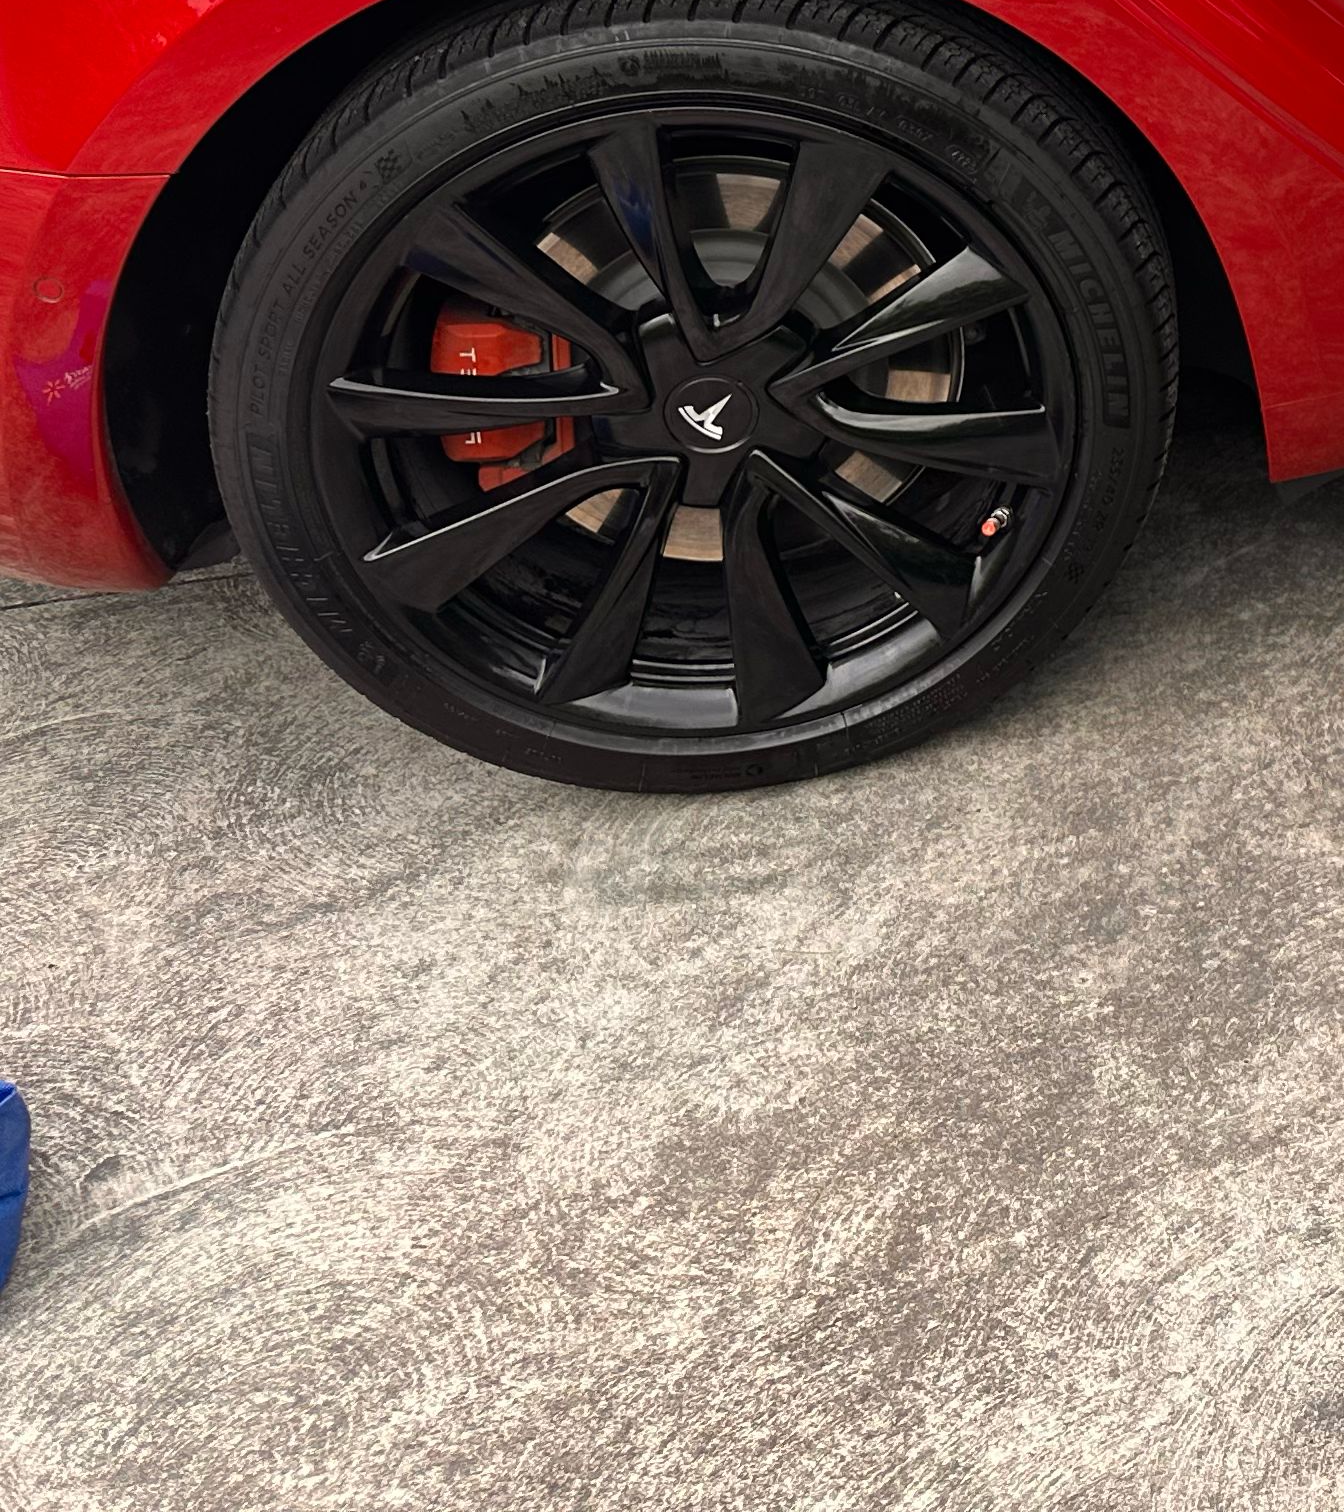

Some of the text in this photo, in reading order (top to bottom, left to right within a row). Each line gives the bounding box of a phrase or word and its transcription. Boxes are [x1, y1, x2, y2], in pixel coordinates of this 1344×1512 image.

[304, 189, 358, 261] SEASON
[281, 262, 307, 298] ALL
[258, 301, 286, 361] SPORT
[1047, 226, 1130, 418] MICHELIN
[249, 364, 268, 418] PILOT
[1102, 446, 1126, 506] 235/40
